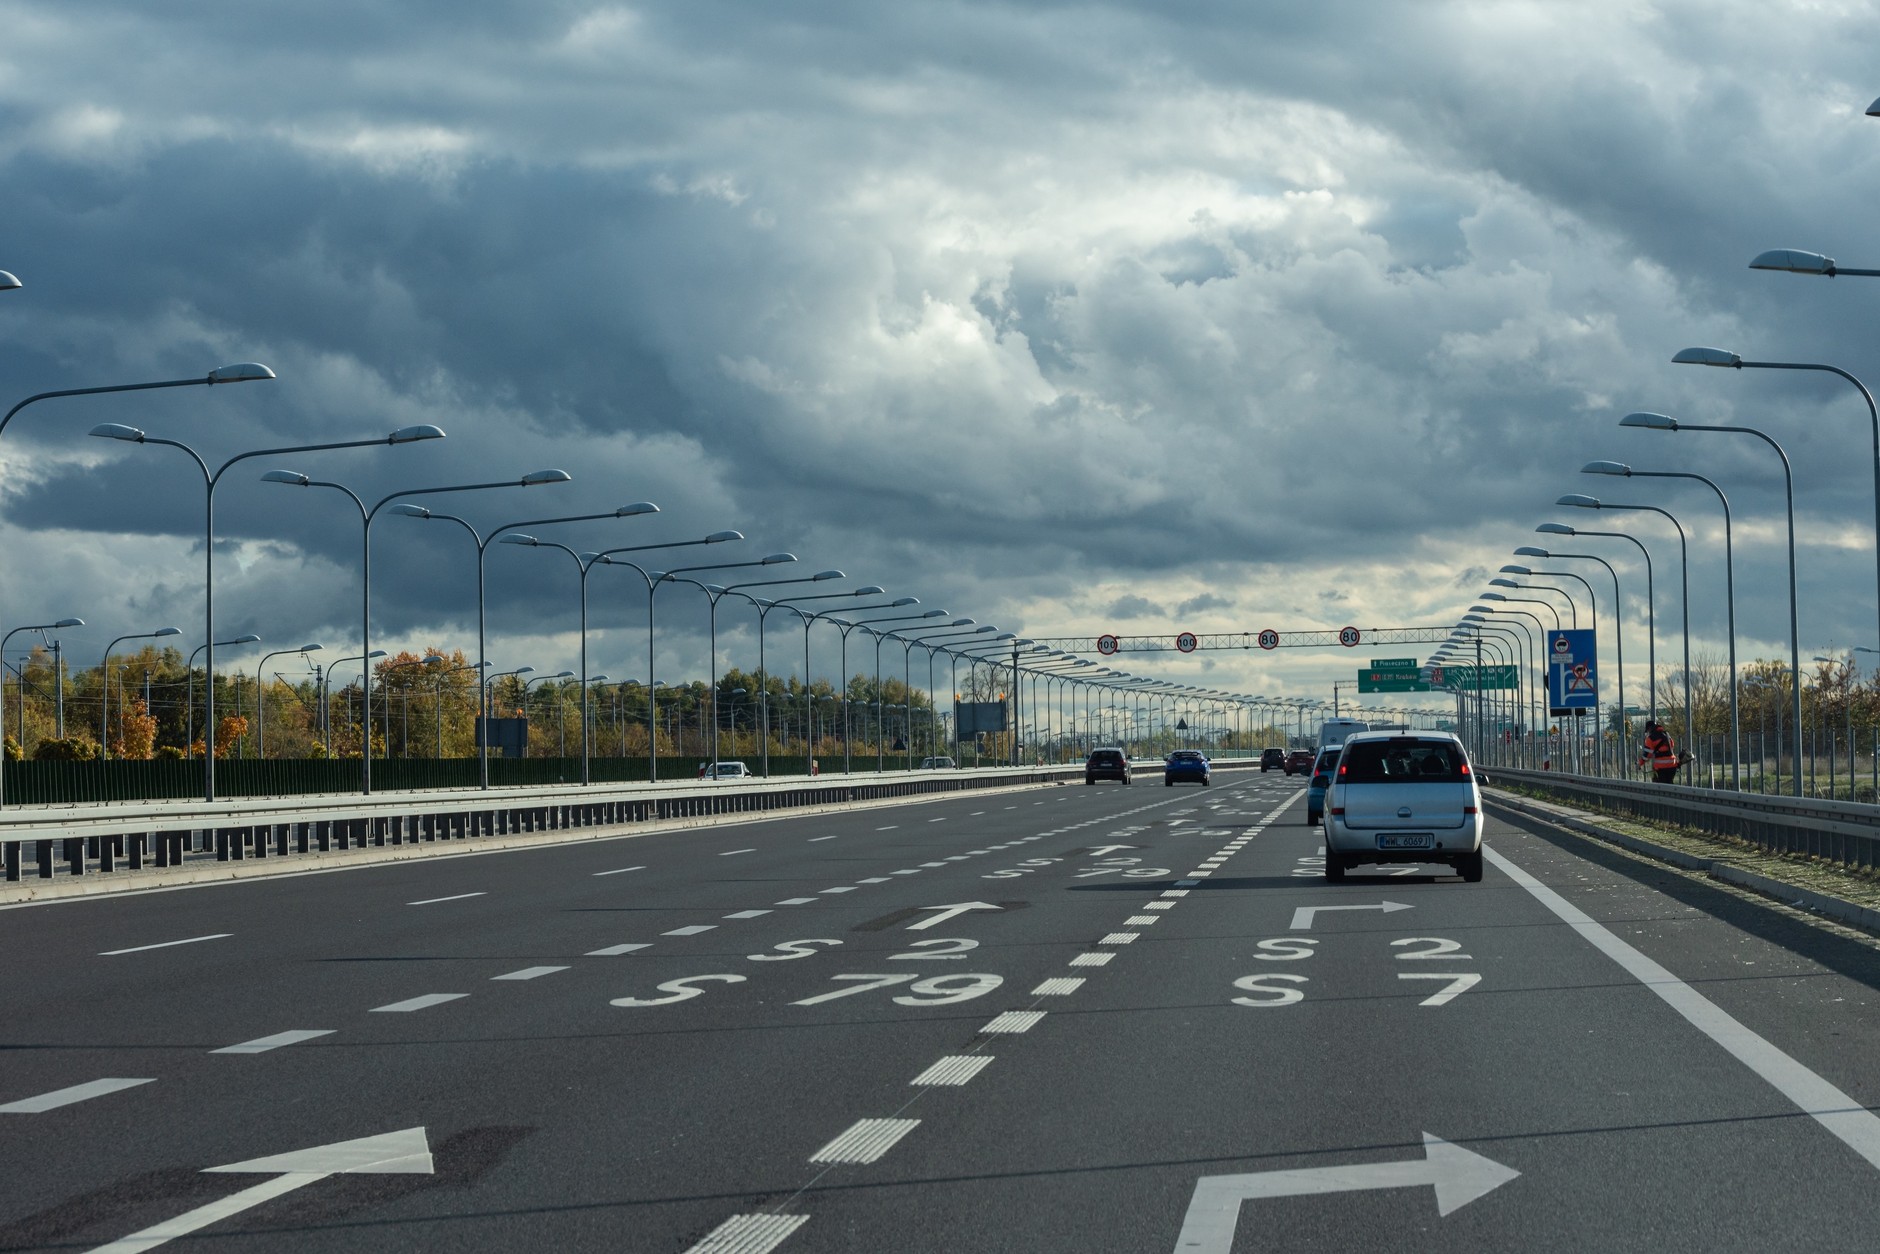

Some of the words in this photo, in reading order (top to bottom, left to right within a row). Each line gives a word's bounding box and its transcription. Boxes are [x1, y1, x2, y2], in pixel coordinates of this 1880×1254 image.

[1261, 634, 1277, 645] 80
[1343, 631, 1358, 642] 80
[1099, 640, 1116, 649] 100
[1179, 638, 1195, 647] 100
[1403, 837, 1428, 846] 6069J
[746, 938, 844, 961] S
[886, 937, 980, 960] 2
[1252, 937, 1320, 961] S
[1390, 937, 1473, 960] 2
[609, 974, 747, 1007] S
[787, 973, 1004, 1006] 79
[1230, 973, 1310, 1007] S
[1397, 973, 1482, 1007] 7
